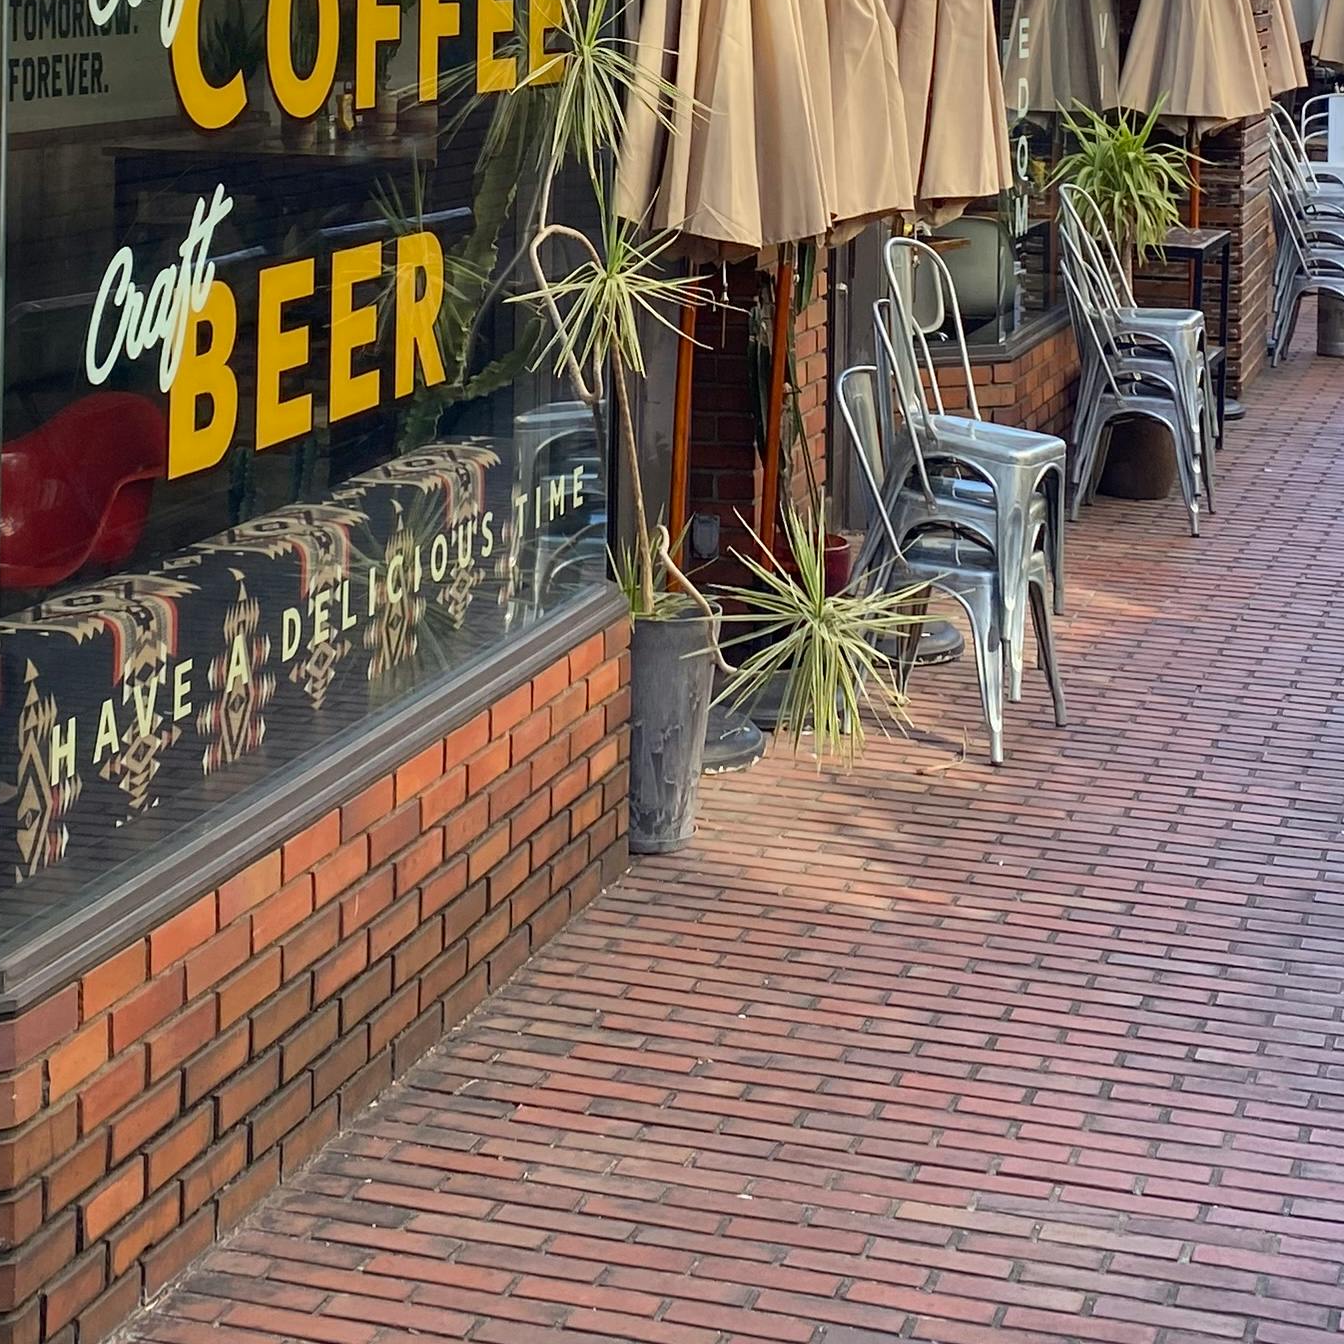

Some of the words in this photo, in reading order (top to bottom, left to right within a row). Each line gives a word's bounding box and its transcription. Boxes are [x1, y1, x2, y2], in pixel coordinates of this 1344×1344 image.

[9, 52, 109, 102] FOREVER.
[86, 183, 234, 393] Craft
[167, 231, 446, 481] BEER
[51, 658, 194, 786] HAVE
[225, 634, 251, 693] A
[281, 511, 494, 662] DELICIOUS
[515, 465, 585, 538] TIME
